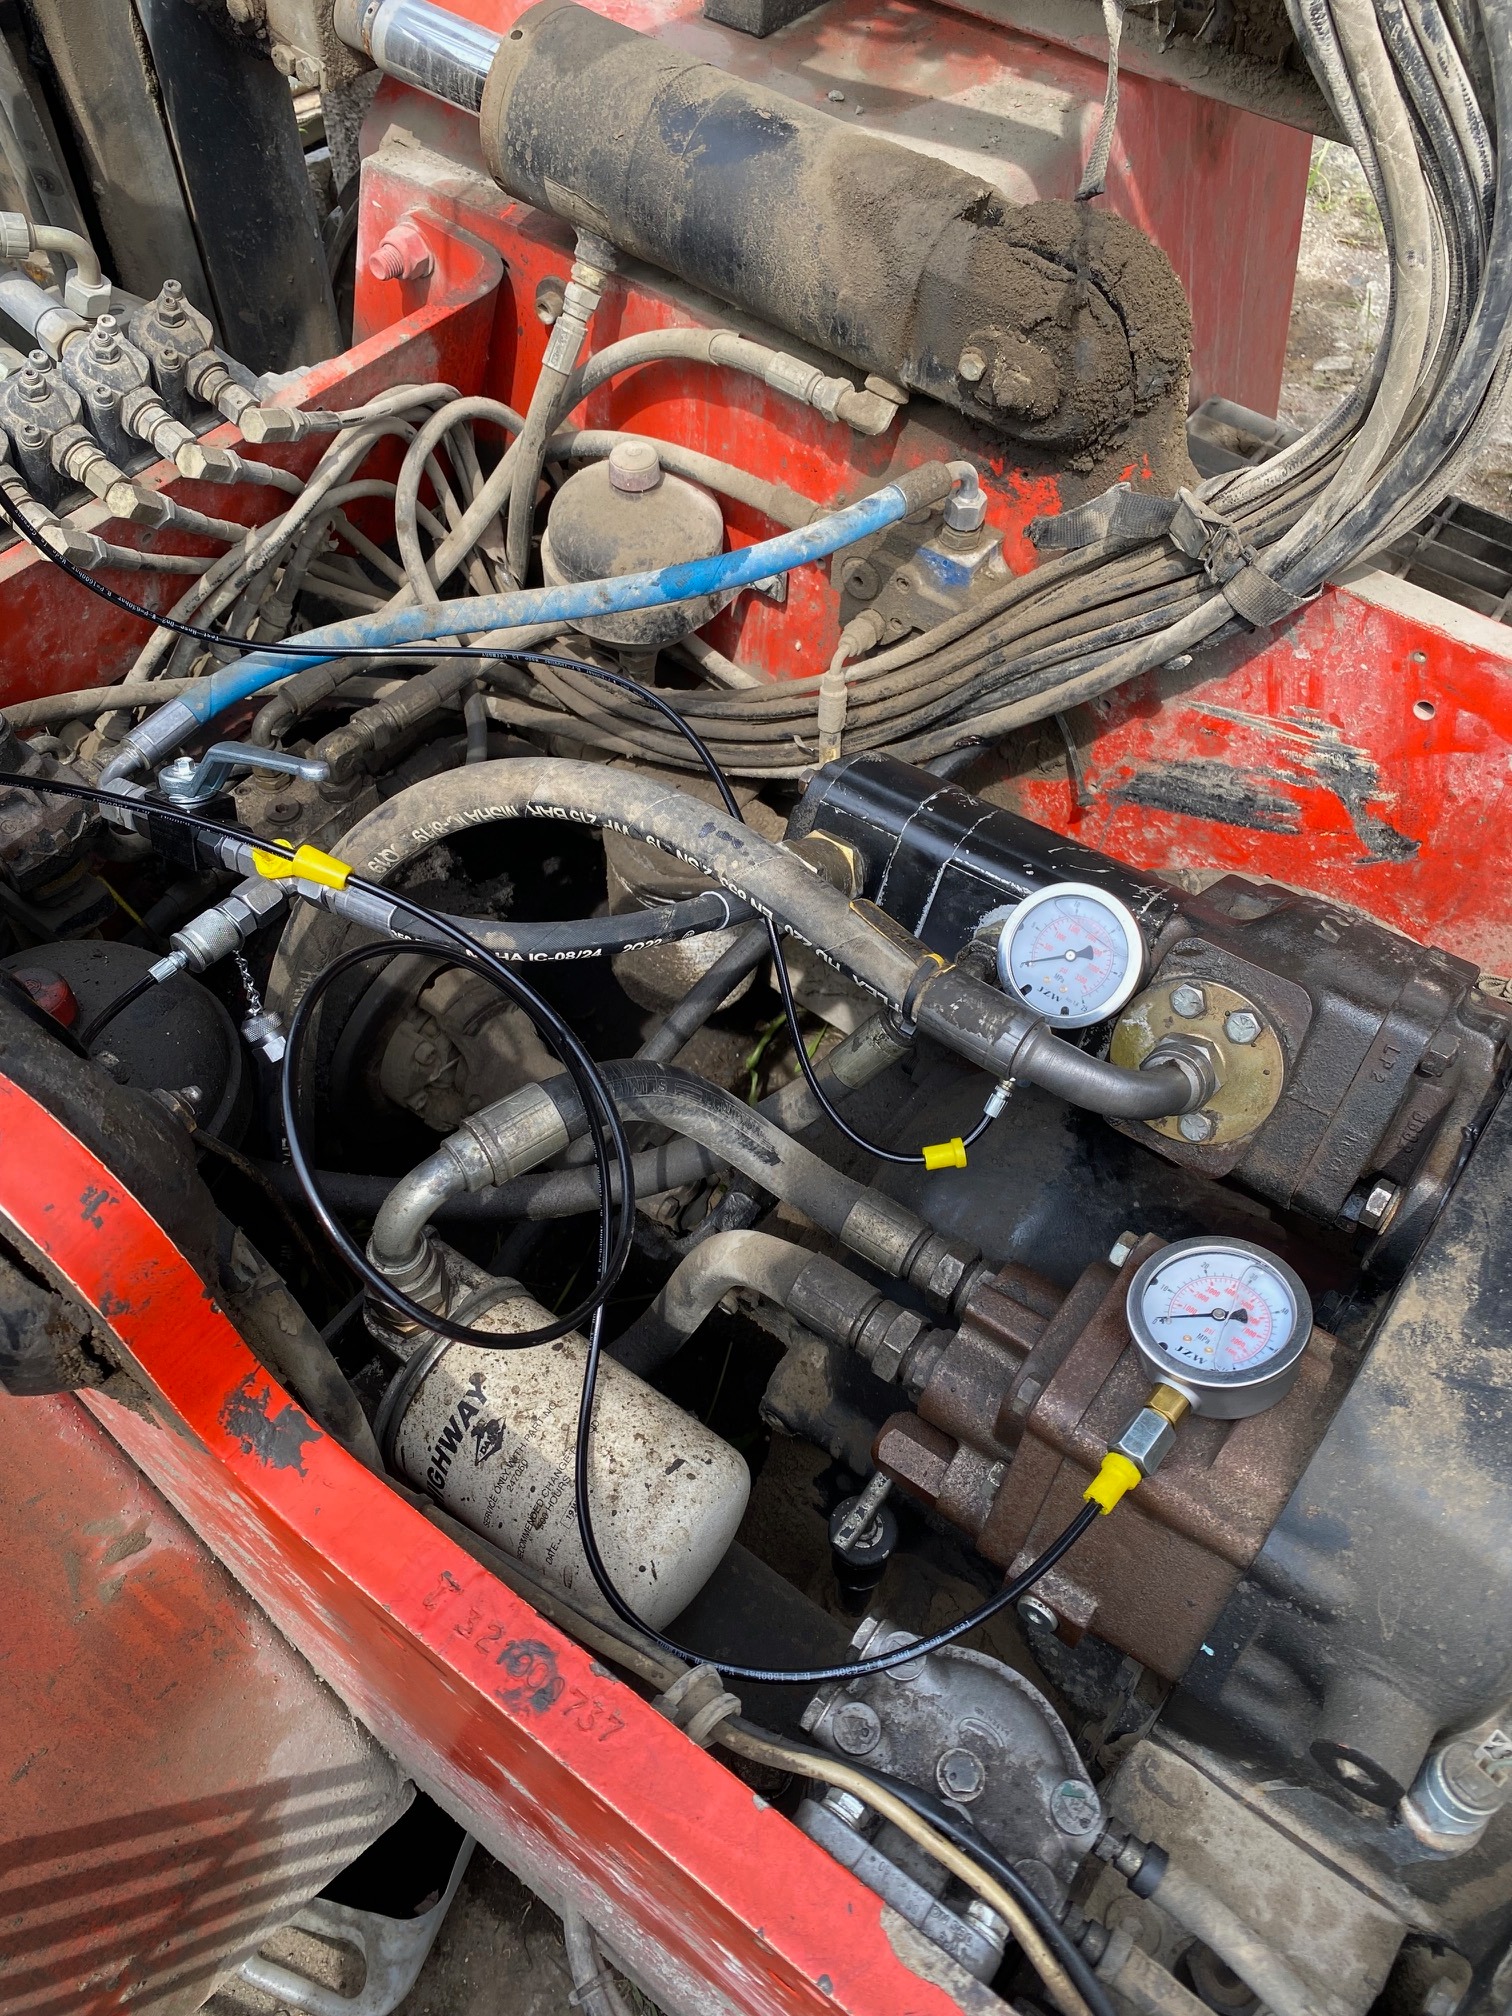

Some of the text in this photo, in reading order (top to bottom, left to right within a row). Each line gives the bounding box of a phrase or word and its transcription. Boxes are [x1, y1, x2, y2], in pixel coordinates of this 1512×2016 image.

[463, 804, 520, 824] MSHA
[527, 804, 568, 820] BAR
[529, 948, 602, 963] IC-08/24
[482, 1494, 498, 1529] SERVICE
[494, 1468, 510, 1494] ONLY
[524, 1418, 543, 1443] PART
[541, 1453, 575, 1498] CHANGE
[547, 1475, 572, 1512] HOURS
